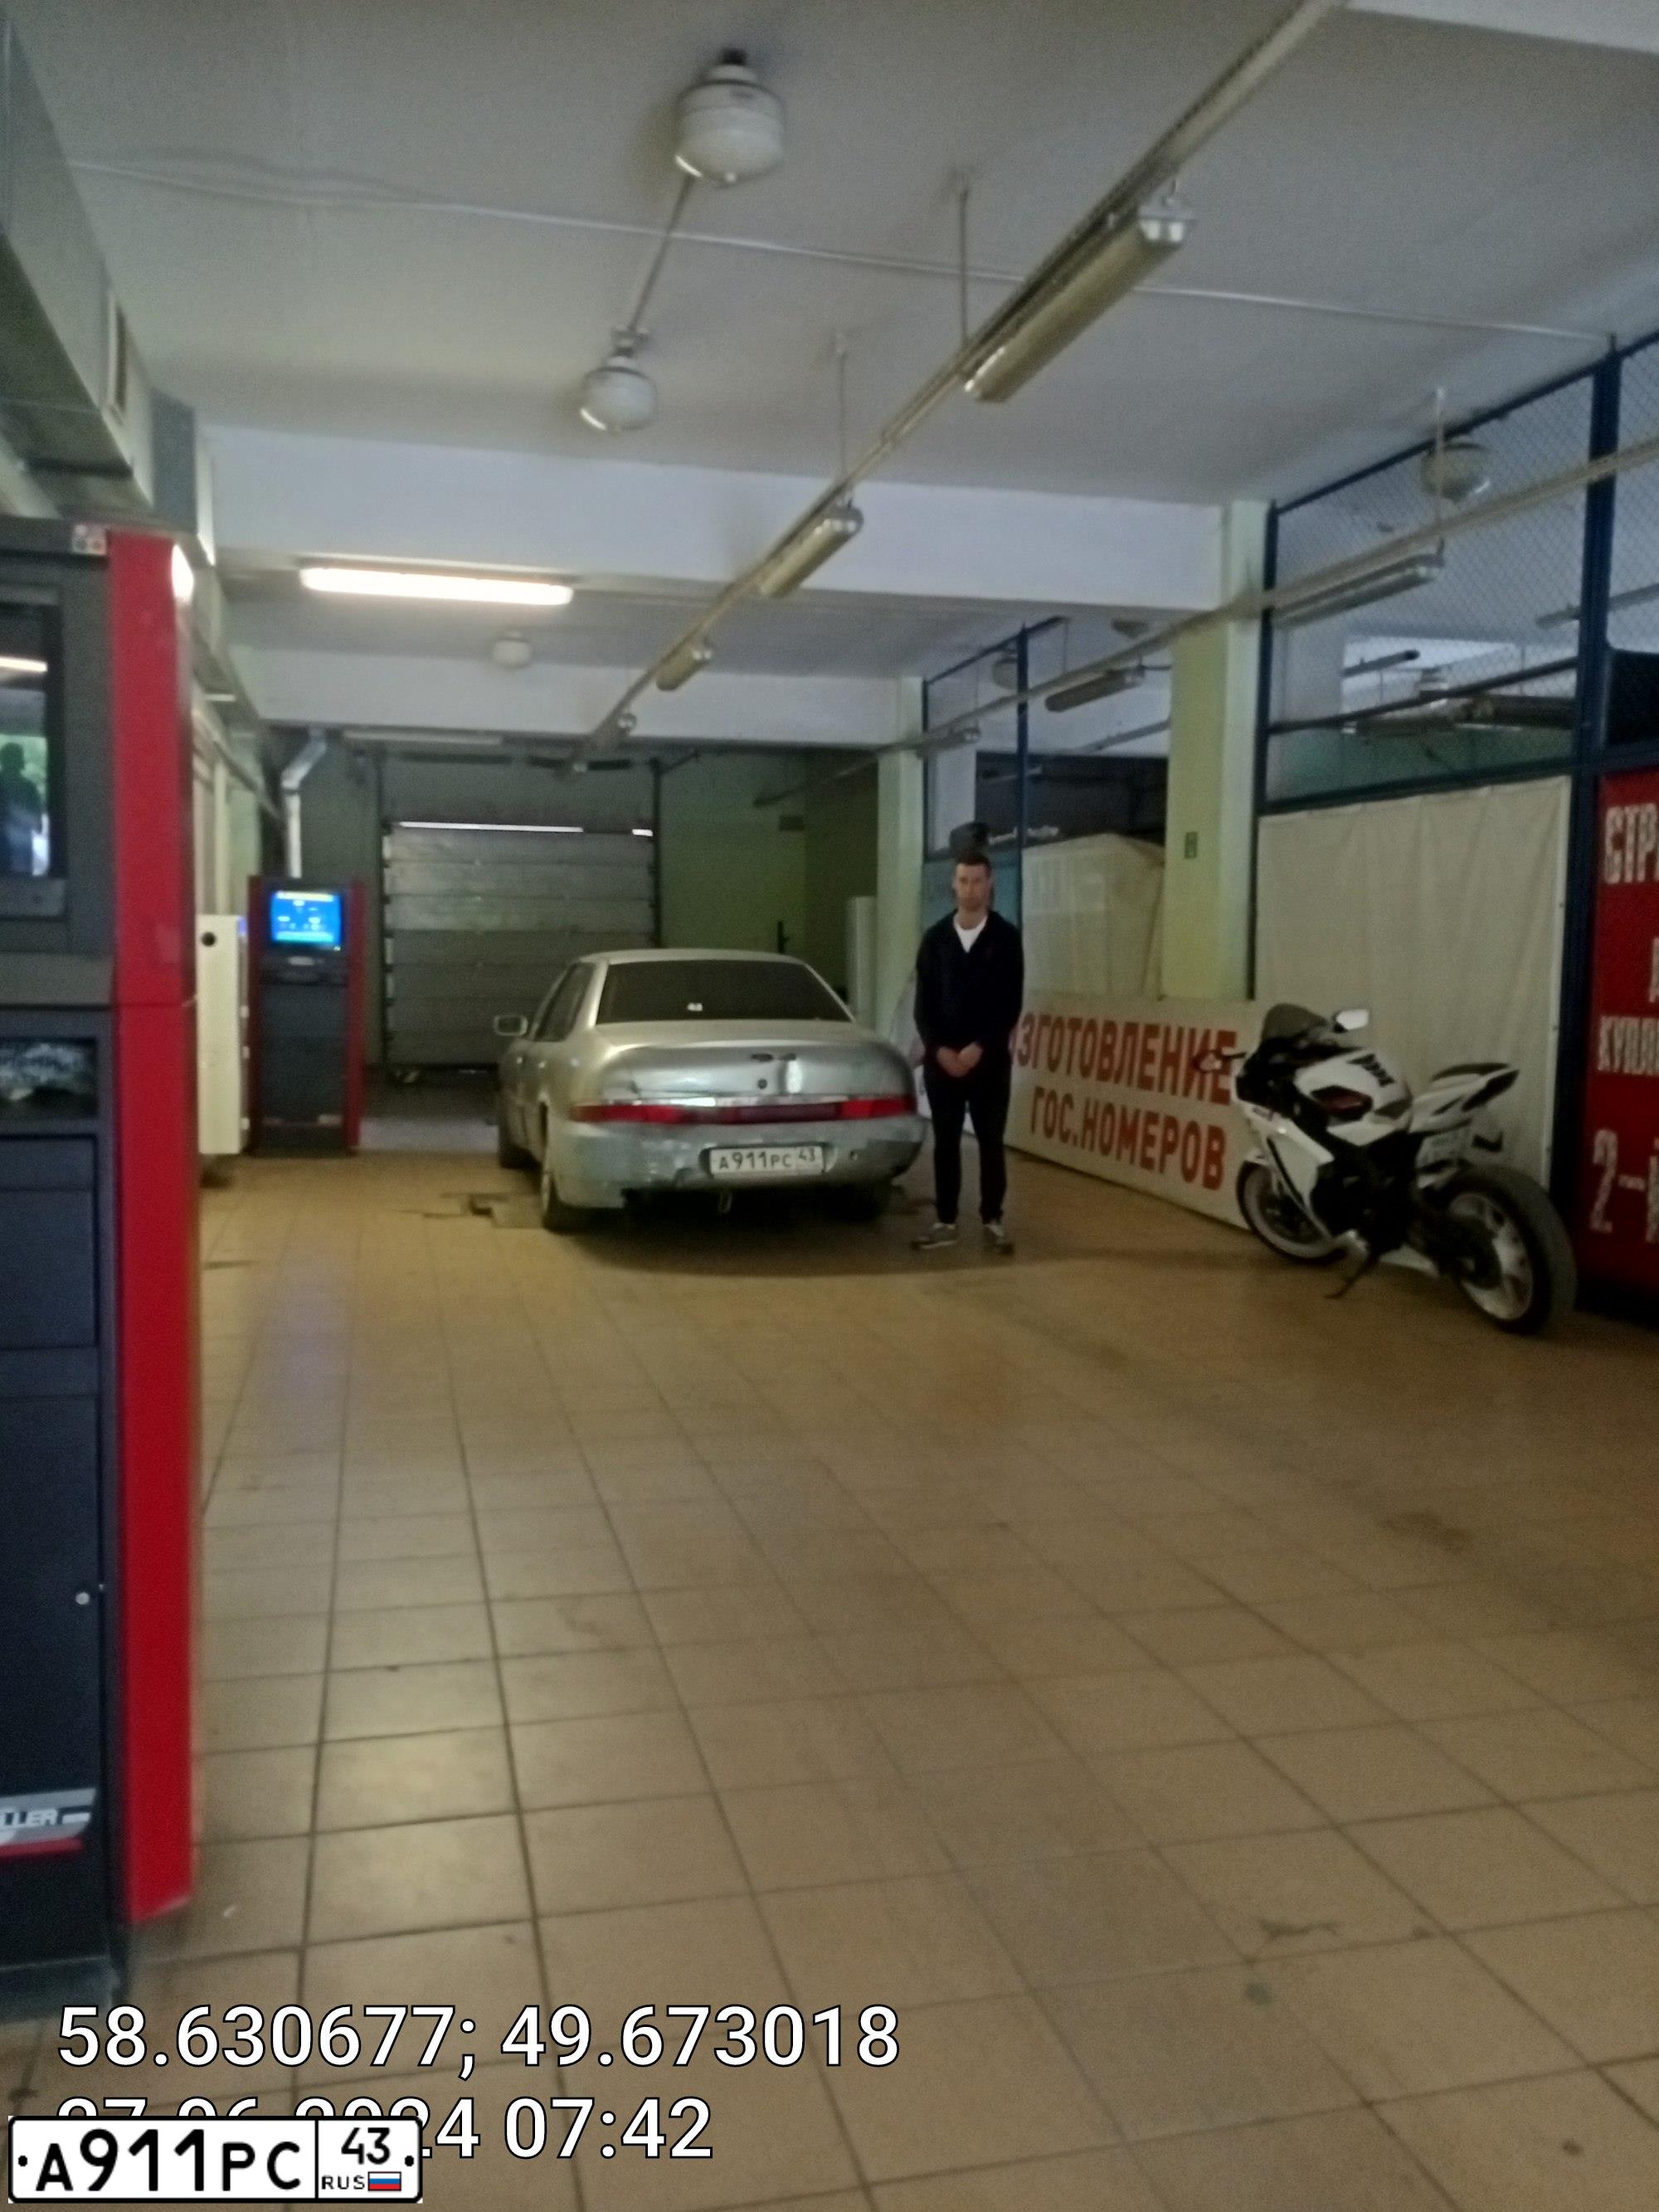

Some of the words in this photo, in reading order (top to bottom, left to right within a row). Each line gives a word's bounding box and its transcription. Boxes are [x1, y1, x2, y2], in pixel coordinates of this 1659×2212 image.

[1603, 802, 1659, 884] СТР
[1014, 1011, 1237, 1106] ЗГОТОВЛЕНИЕ
[719, 1151, 792, 1170] А911РС
[1029, 1085, 1227, 1191] ГОС.НОМЕРОВ
